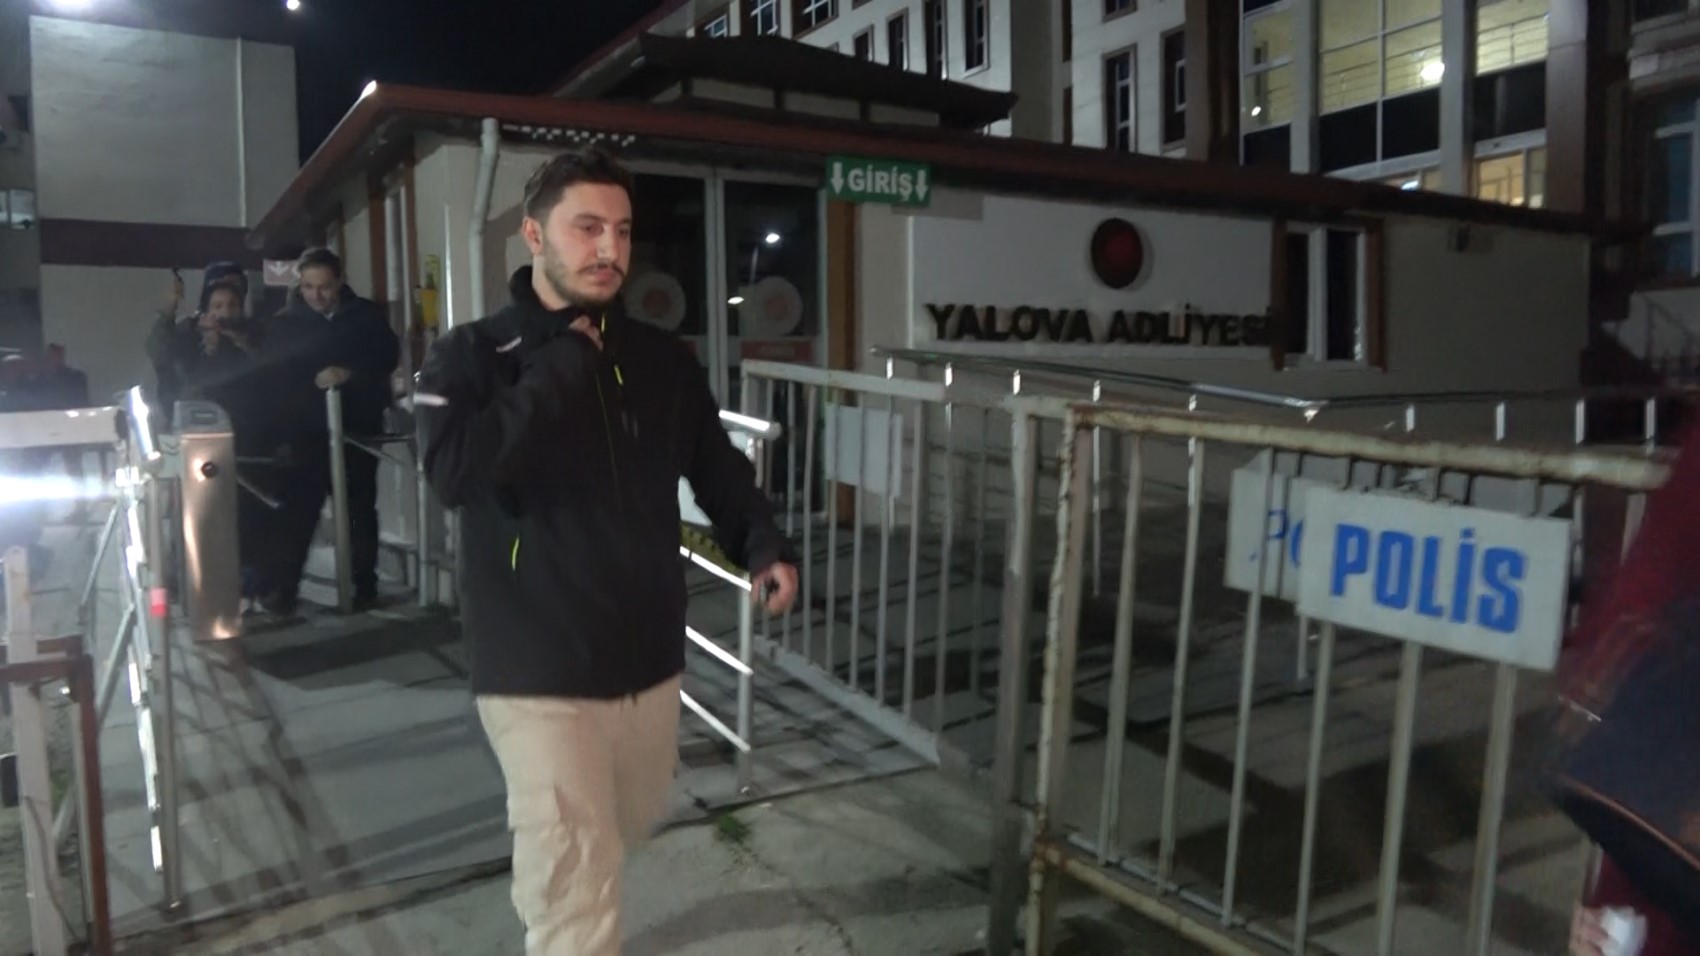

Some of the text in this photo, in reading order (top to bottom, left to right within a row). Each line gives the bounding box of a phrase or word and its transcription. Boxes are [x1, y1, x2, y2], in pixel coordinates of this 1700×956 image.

[847, 164, 913, 202] GİRİŞ
[927, 303, 1092, 343] YALOVA
[1330, 522, 1527, 634] POLİS
